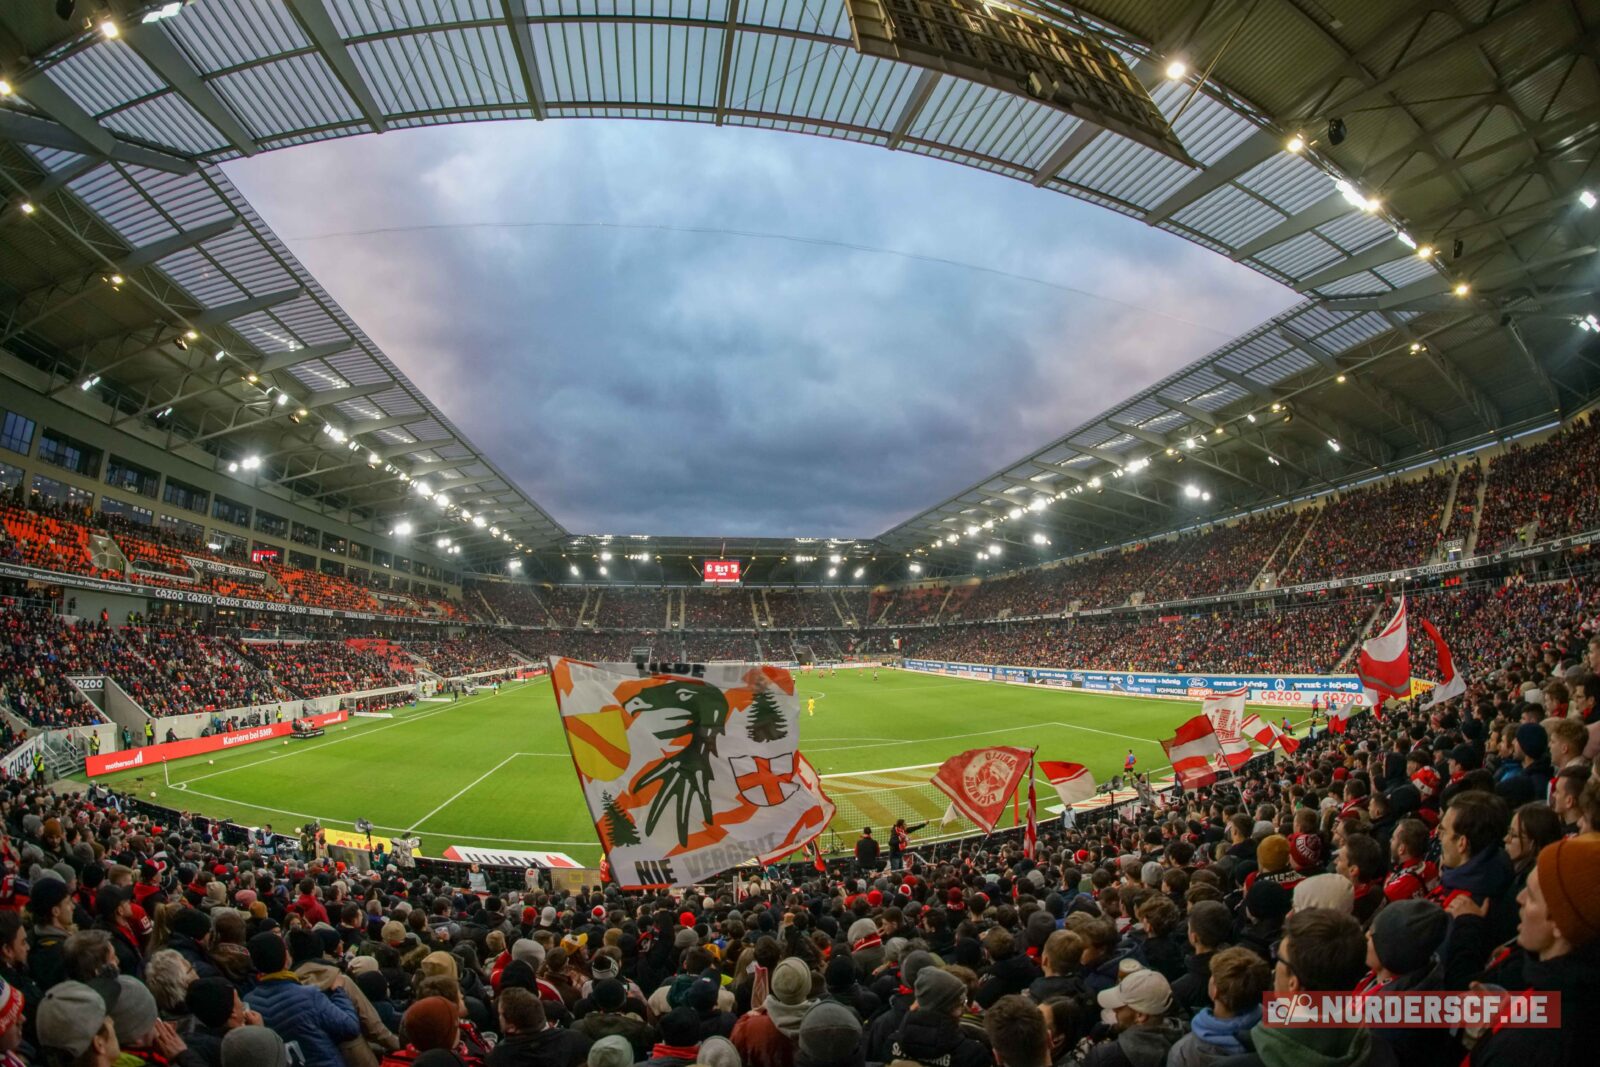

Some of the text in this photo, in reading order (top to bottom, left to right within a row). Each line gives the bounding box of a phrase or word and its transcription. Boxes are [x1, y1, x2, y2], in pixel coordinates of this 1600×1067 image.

[208, 564, 225, 572] CAZOO
[229, 567, 245, 575] CAZOO
[1417, 562, 1458, 575] SCHWEIGER
[1352, 574, 1390, 585] SCHWEIGER
[1295, 582, 1328, 593] SCHWEIGER
[155, 589, 183, 600] CAZOO
[187, 593, 212, 604] CAZOO
[216, 597, 240, 606] CAZOO
[243, 600, 264, 610] CAZOO
[267, 603, 286, 612] CAZOO
[289, 606, 306, 614] CAZOO
[1329, 682, 1358, 690] könig
[1261, 691, 1301, 700] CAZOO
[1323, 692, 1362, 704] CAZOO
[223, 728, 273, 745] Karriere bei SMP.
[10, 746, 34, 776] GUTEX
[105, 760, 134, 770] motherson
[634, 858, 678, 885] NIE
